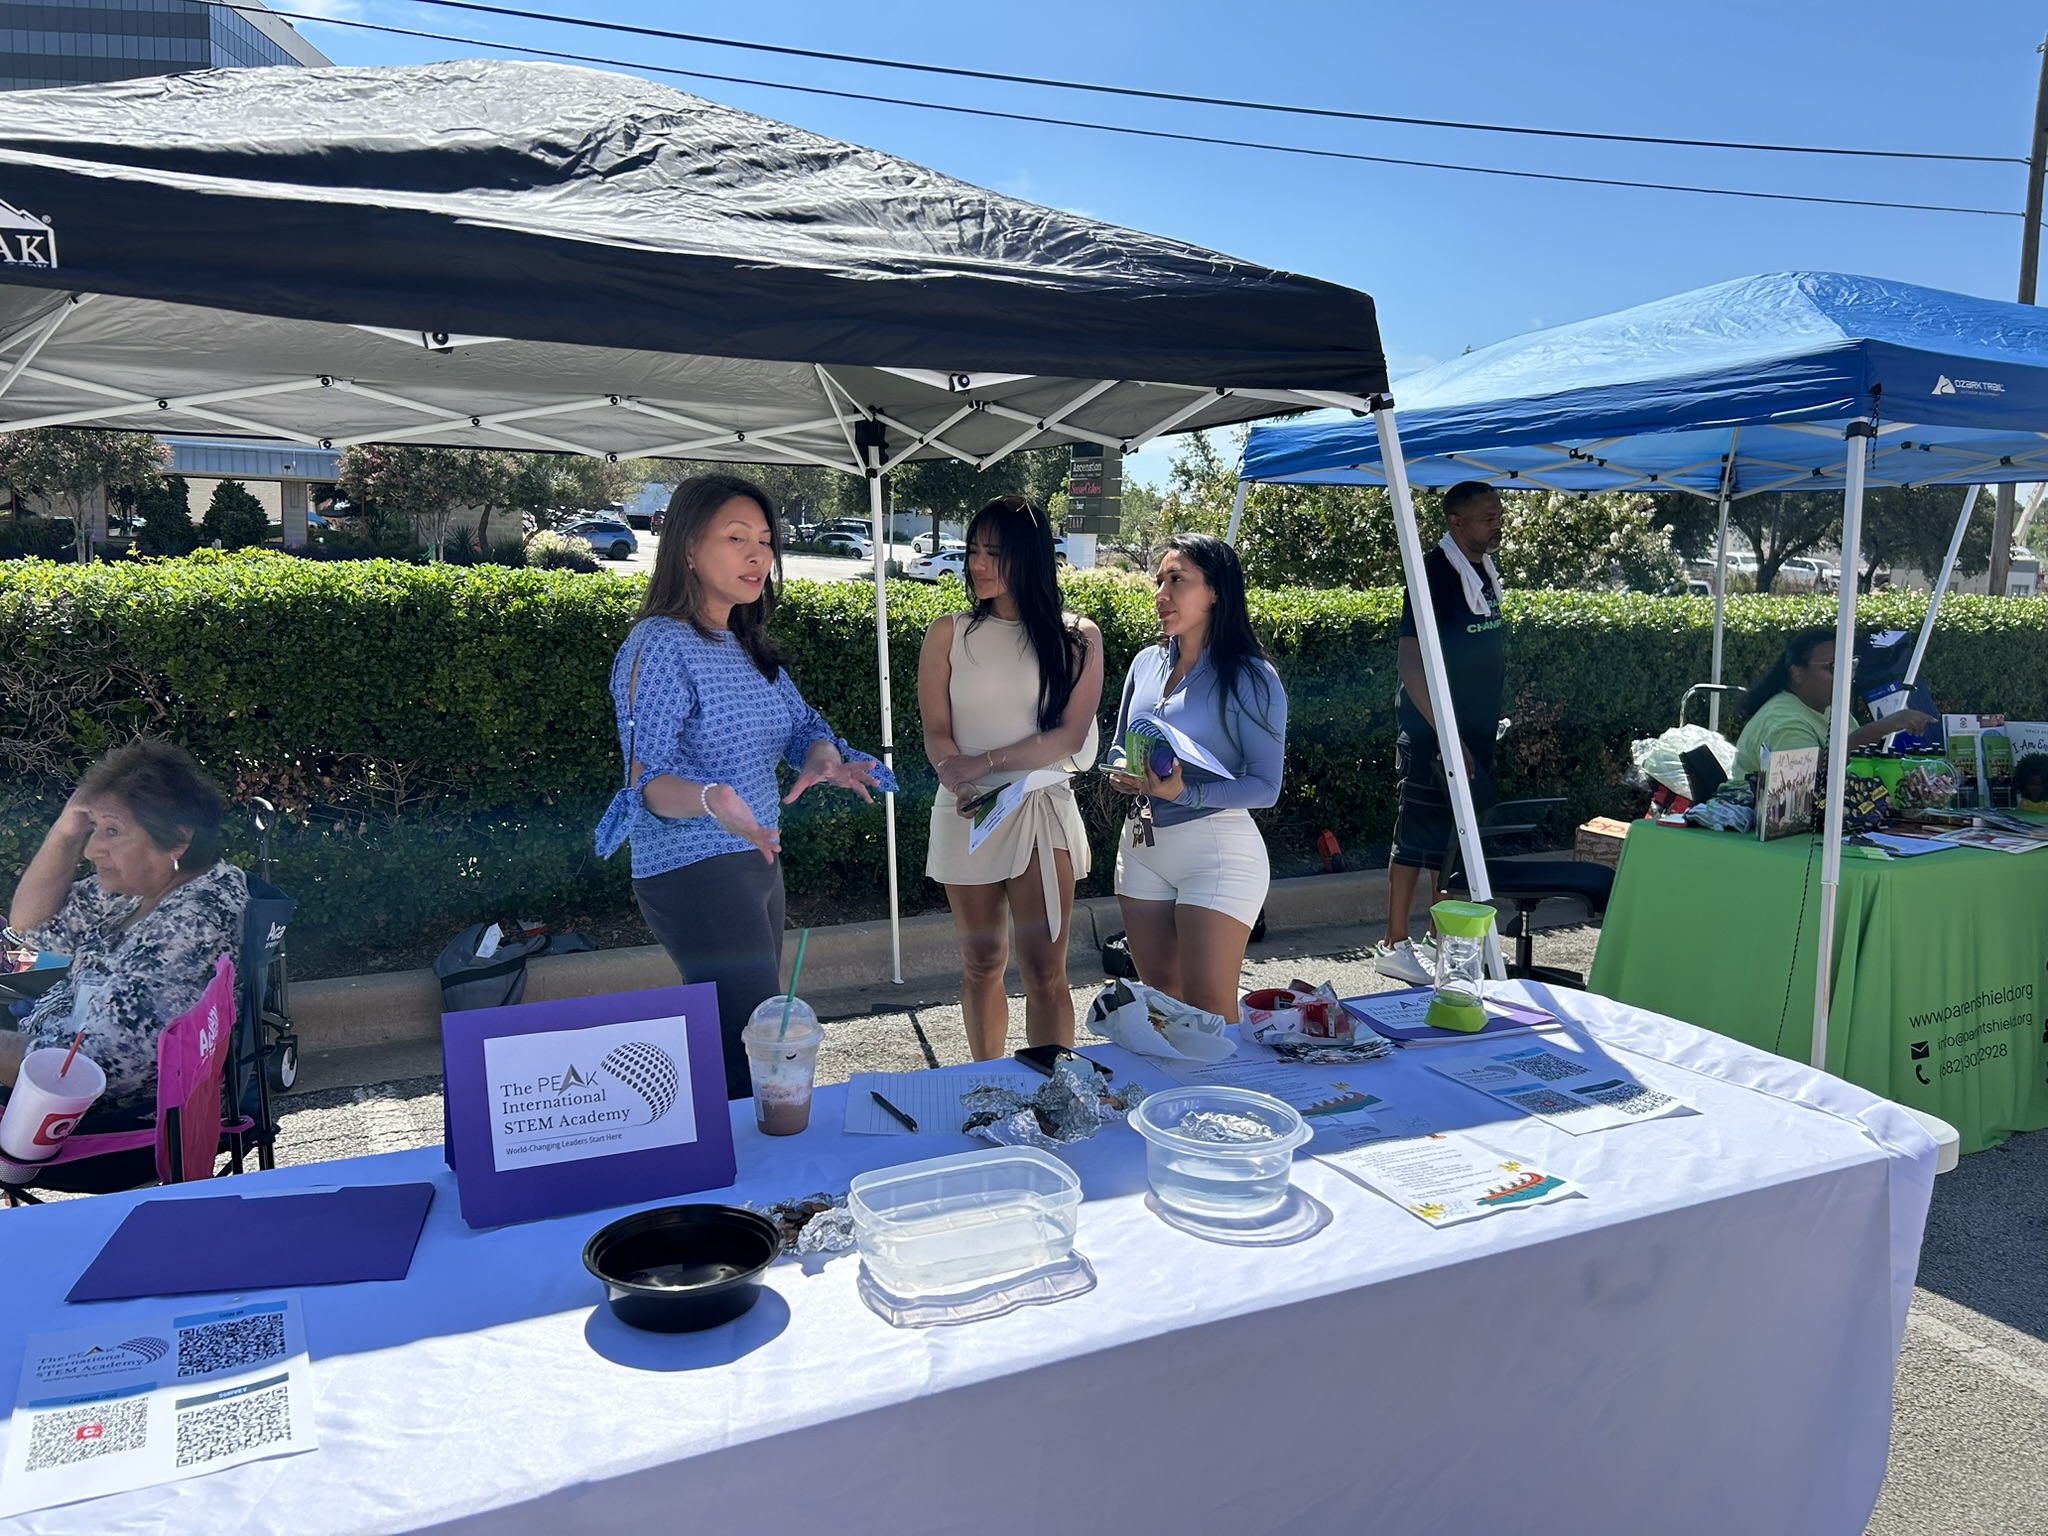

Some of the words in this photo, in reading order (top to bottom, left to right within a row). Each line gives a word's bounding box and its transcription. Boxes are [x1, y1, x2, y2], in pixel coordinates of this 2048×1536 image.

[1954, 379, 1982, 389] OZARK
[1982, 382, 2006, 392] TRAIL
[500, 1083, 532, 1098] The
[538, 1063, 599, 1096] PEAK
[502, 1088, 606, 1115] International
[45, 1117, 80, 1140] Q
[504, 1116, 554, 1135] STEM
[559, 1108, 630, 1127] Academy
[506, 1141, 561, 1155] World-Changing
[561, 1138, 588, 1148] Leaders
[589, 1135, 605, 1144] Start
[605, 1133, 622, 1141] Here
[35, 1366, 77, 1379] STEM
[82, 1359, 144, 1372] Academy
[37, 1355, 65, 1364] The
[37, 1352, 125, 1371] International
[218, 1387, 248, 1399] SURVEY
